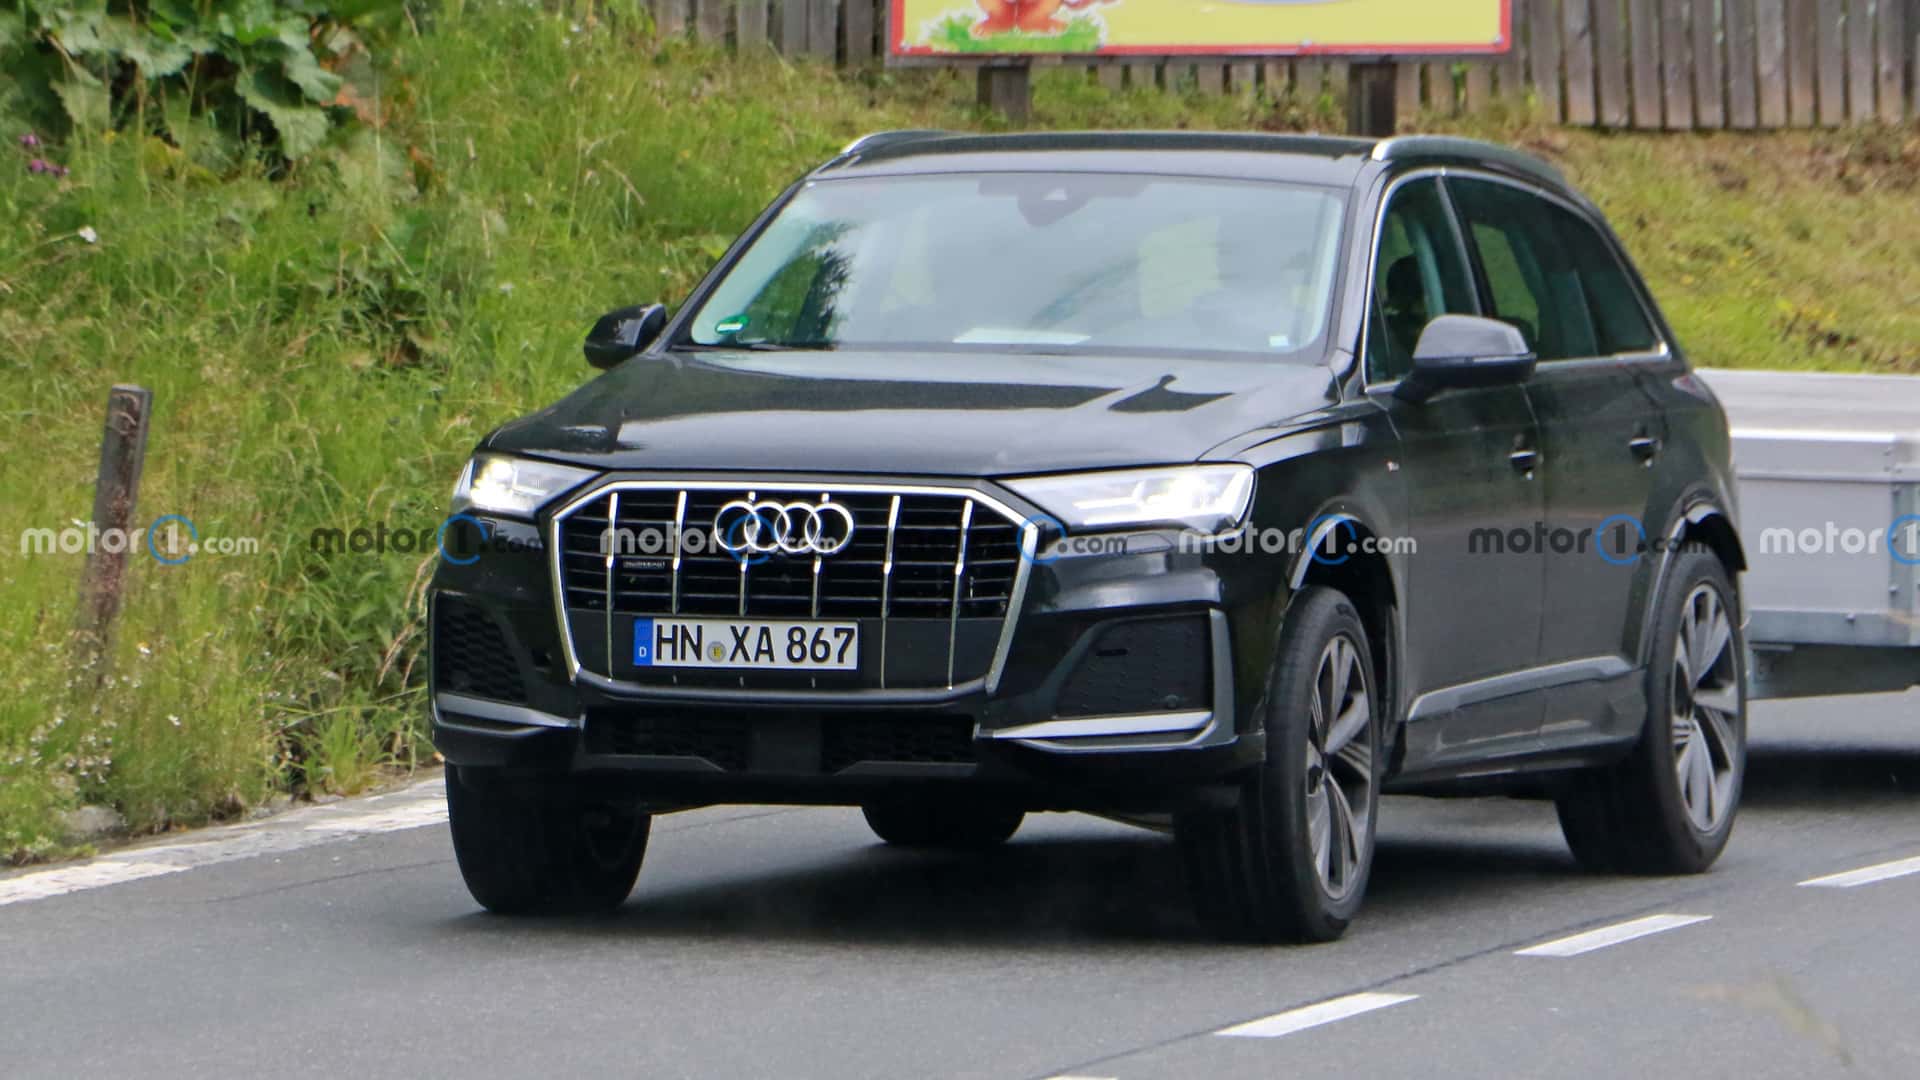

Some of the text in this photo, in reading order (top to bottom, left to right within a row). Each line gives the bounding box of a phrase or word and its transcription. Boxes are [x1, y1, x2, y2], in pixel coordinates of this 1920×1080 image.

[638, 646, 647, 658] D
[655, 624, 855, 664] HN XA 867
